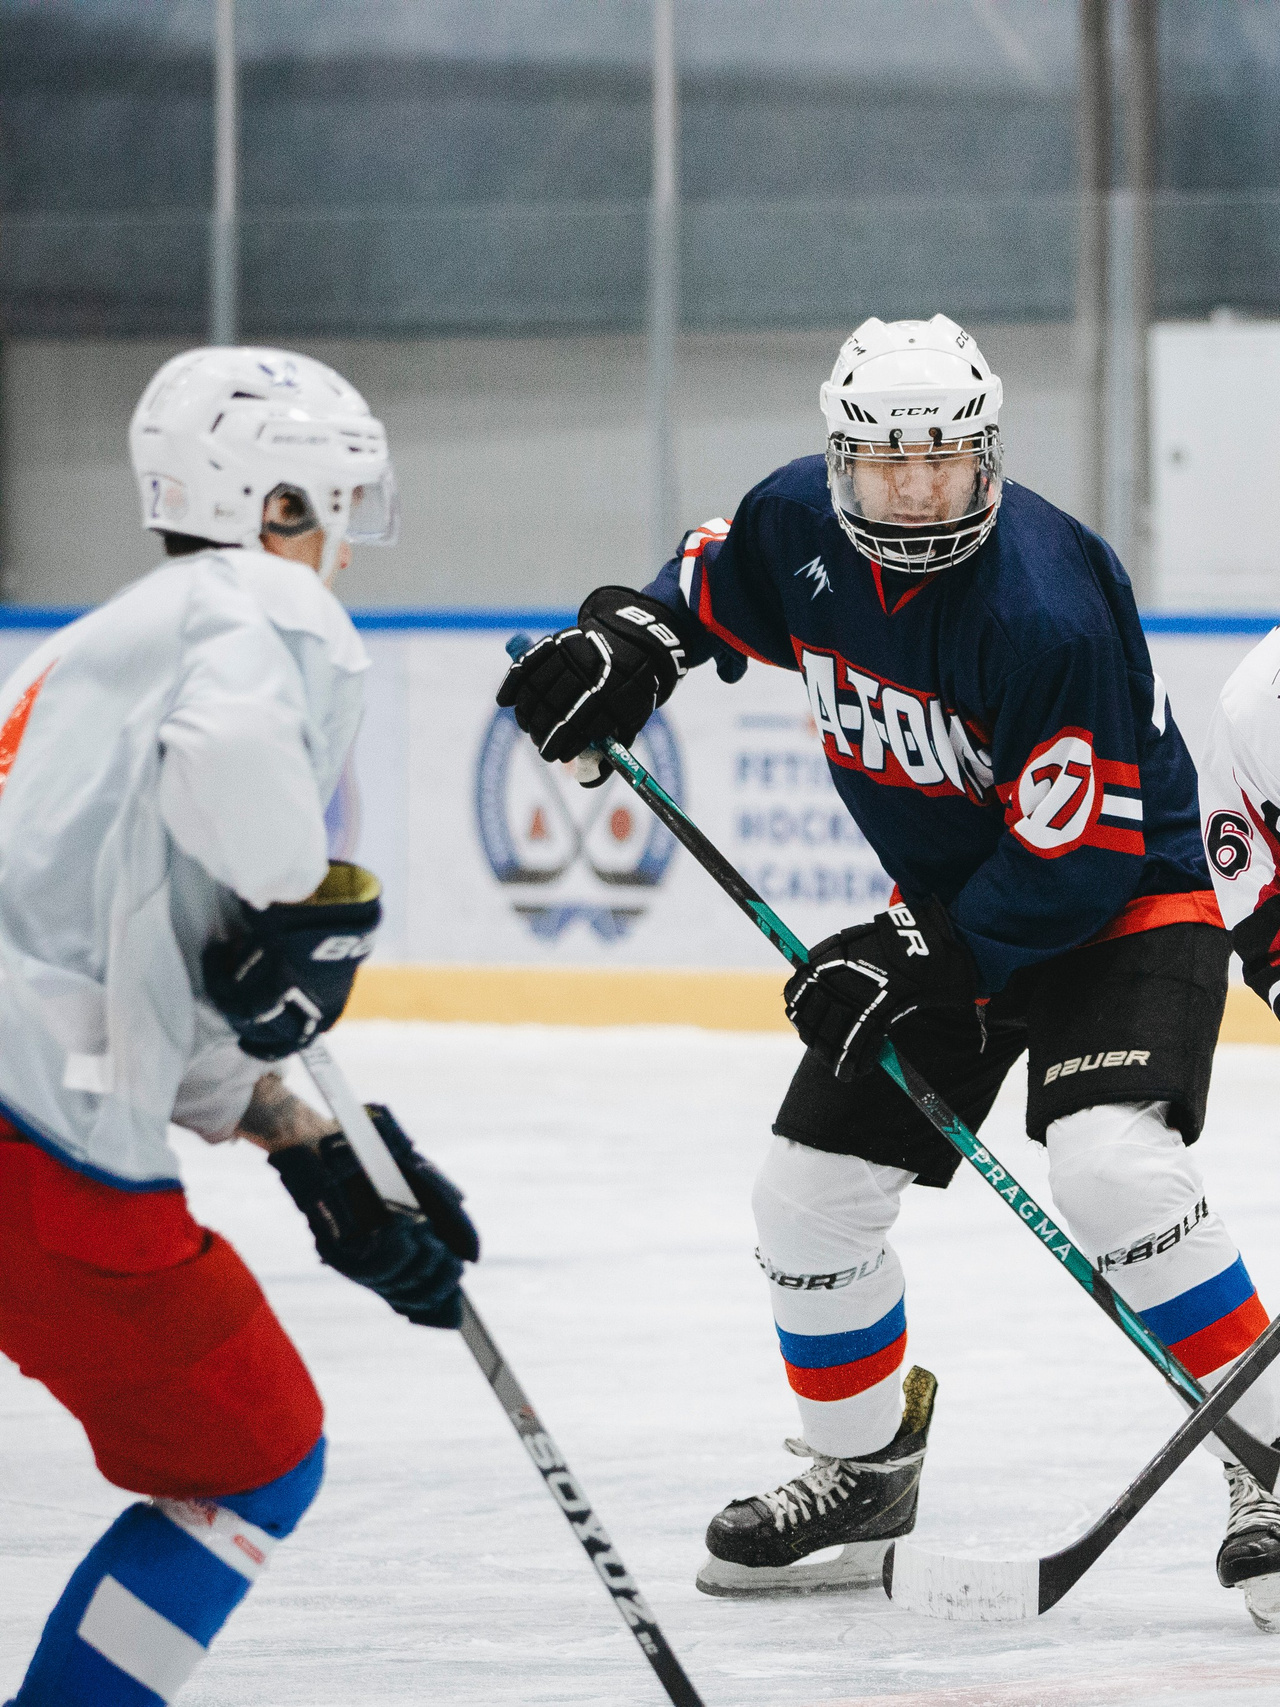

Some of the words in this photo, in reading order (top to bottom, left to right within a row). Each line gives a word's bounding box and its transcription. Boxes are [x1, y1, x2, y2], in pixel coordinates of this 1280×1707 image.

[890, 406, 940, 417] CCM
[1043, 1049, 1152, 1086] BAUER
[970, 1146, 1073, 1263] PRAGMA
[520, 1431, 658, 1627] SOYUZ
